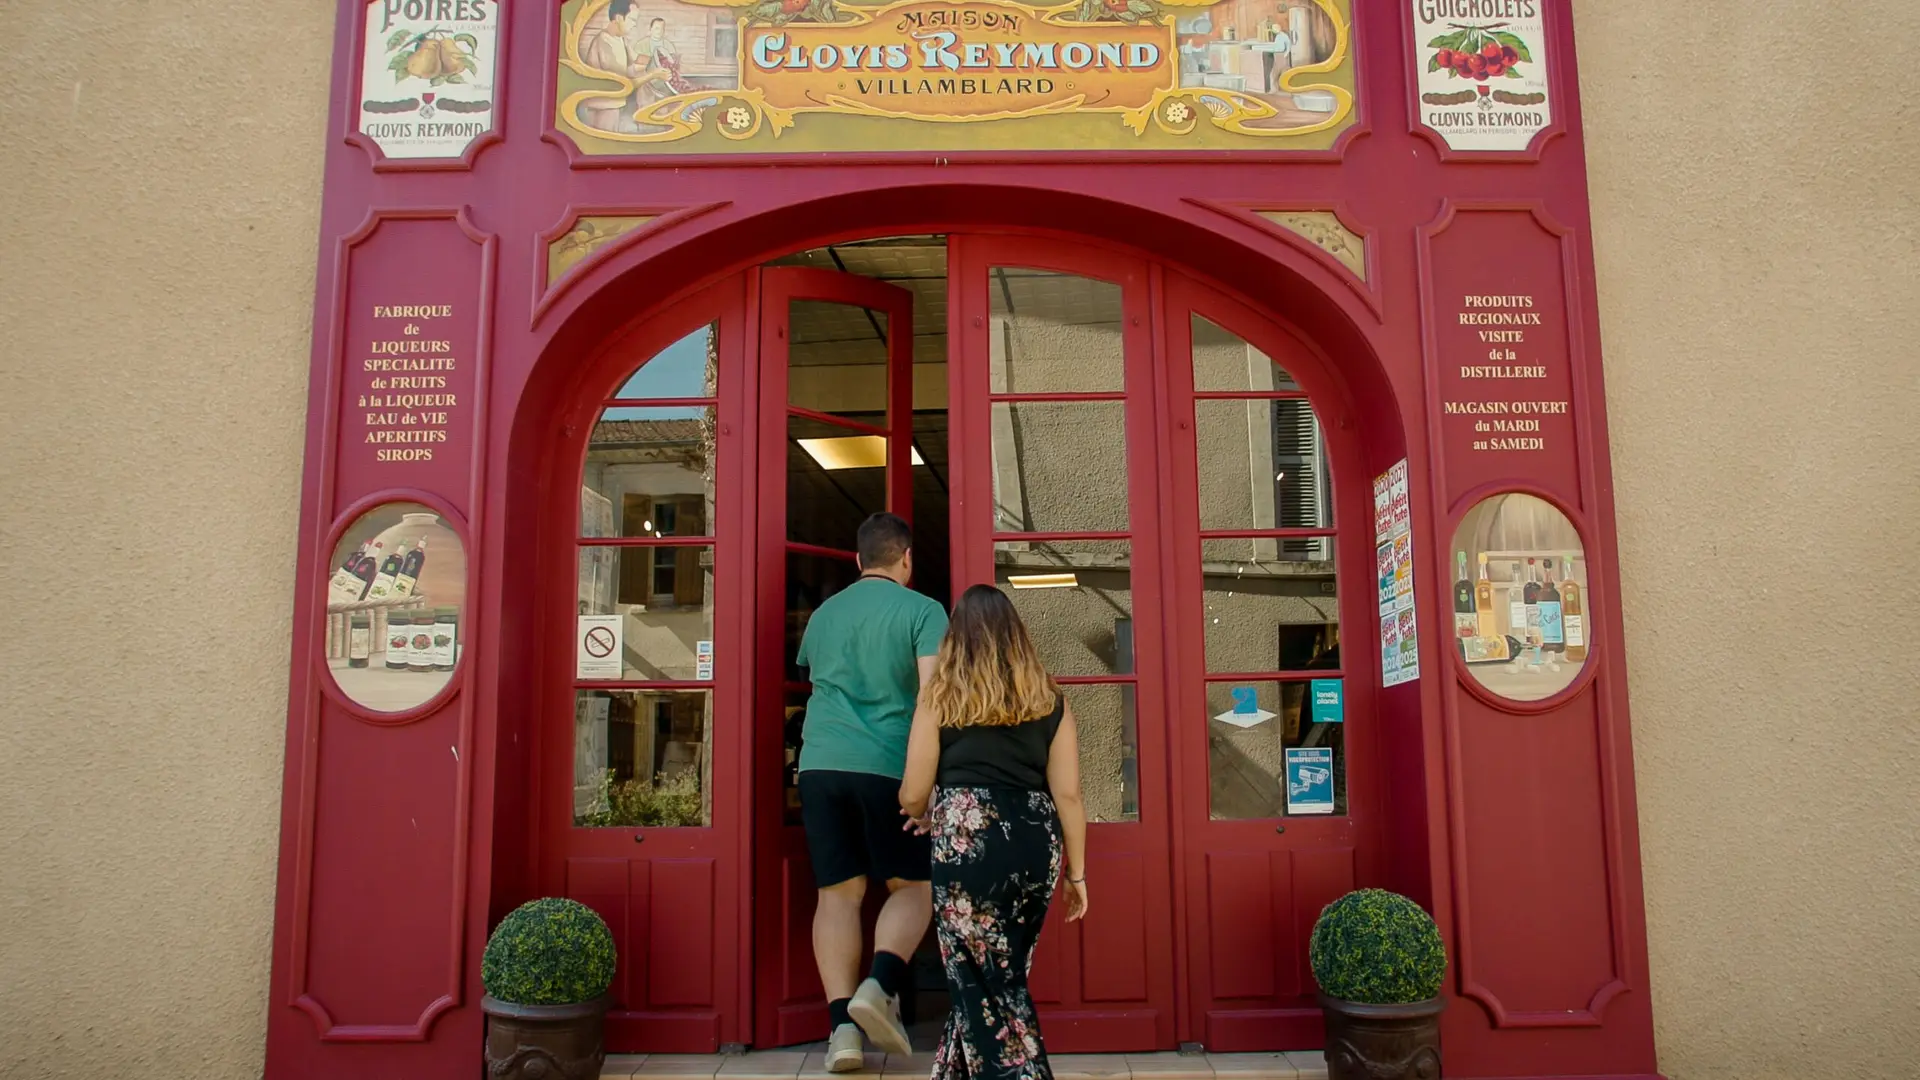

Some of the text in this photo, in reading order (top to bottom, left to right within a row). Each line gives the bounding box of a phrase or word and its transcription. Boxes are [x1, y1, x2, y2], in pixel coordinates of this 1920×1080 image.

[381, 0, 487, 33] POIRES
[1418, 0, 1536, 24] GUIGNOLETS
[896, 10, 1021, 34] MAISON
[752, 31, 1161, 71] CLOVIS REYMOND
[854, 78, 1055, 95] VILLAMBLARD
[1429, 111, 1543, 127] CLOVIS REYMOND
[366, 122, 484, 138] CLOVIS REYMOND
[1464, 295, 1533, 308] PRODUITS
[374, 305, 452, 319] FABRIQUE
[1459, 313, 1541, 325] REGIONAUX
[404, 323, 420, 335] de
[1479, 330, 1524, 343] VISITE
[371, 341, 451, 355] LIQUEURS
[1489, 349, 1516, 360] de la
[363, 358, 456, 372] SPECIALITE
[1460, 366, 1547, 378] DISTILLERIE
[371, 376, 446, 389] de FRUITS
[358, 394, 457, 409] à la LIQUEUR
[1444, 402, 1568, 414] MAGASIN OUVERT
[366, 412, 448, 425] EAU de VIE
[1475, 420, 1540, 432] du MARDI
[364, 430, 447, 444] APERITIFS
[1473, 438, 1544, 450] au SAMEDI
[376, 448, 433, 462] SIROPS
